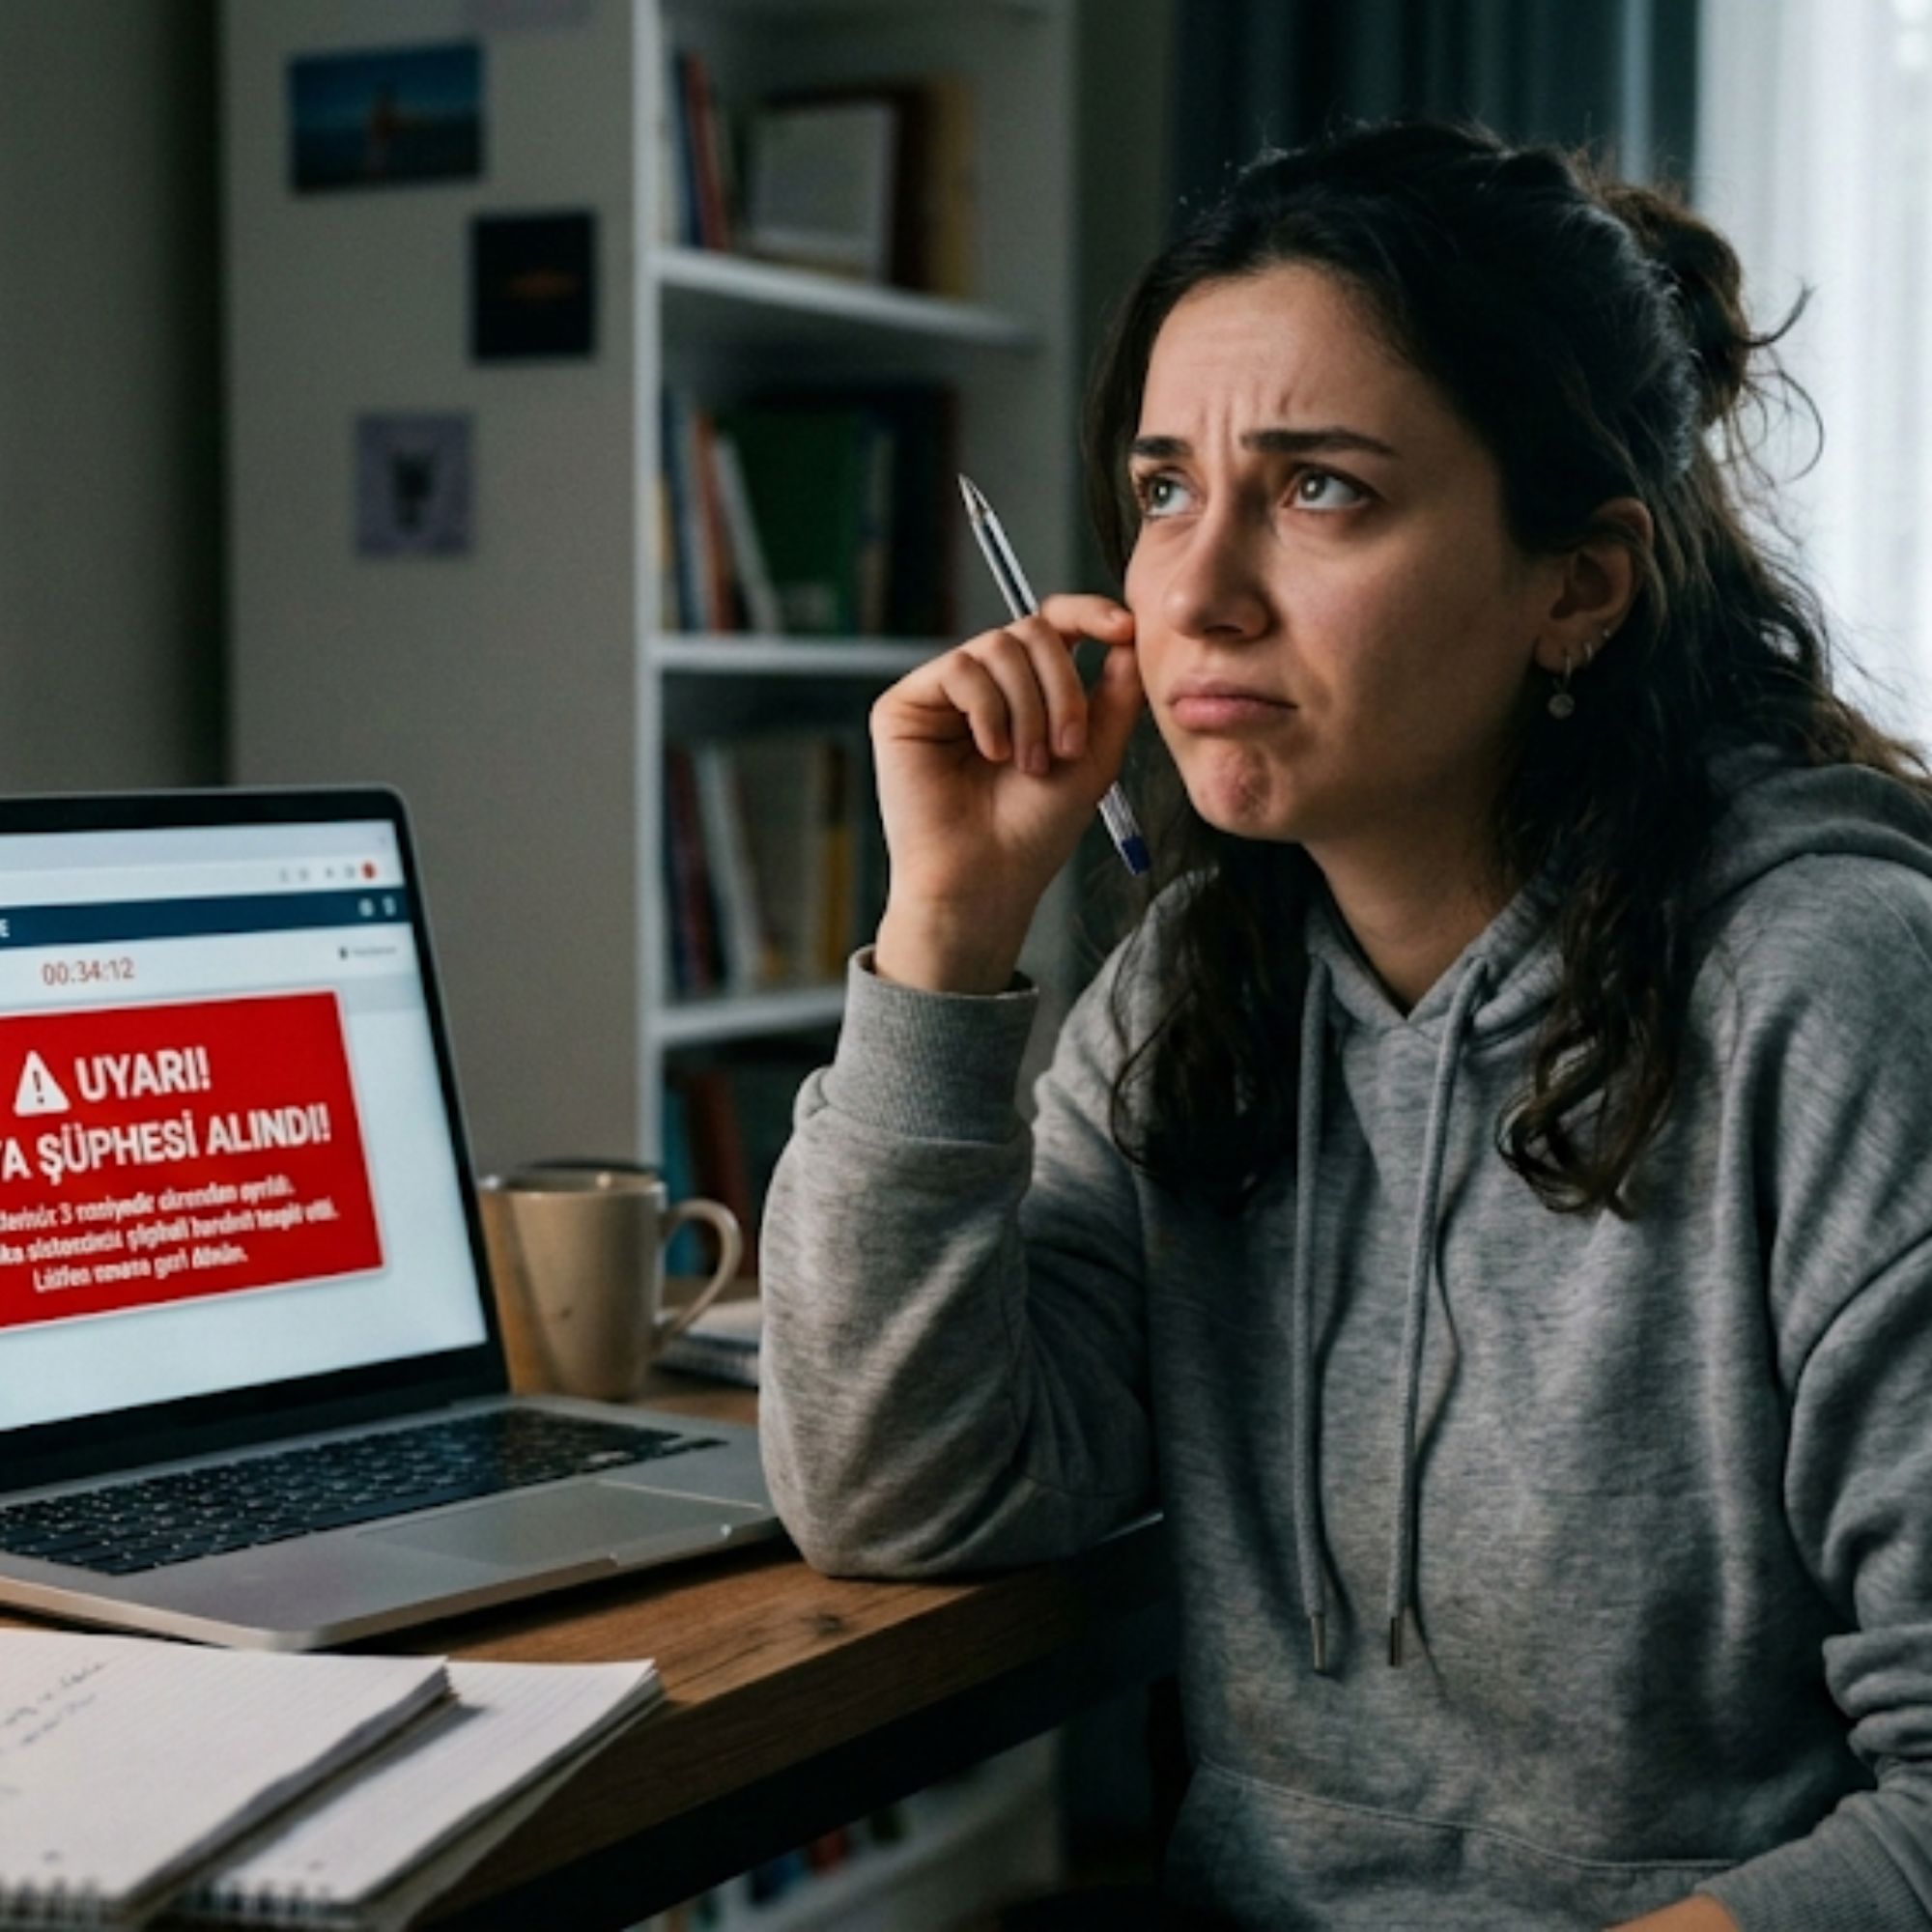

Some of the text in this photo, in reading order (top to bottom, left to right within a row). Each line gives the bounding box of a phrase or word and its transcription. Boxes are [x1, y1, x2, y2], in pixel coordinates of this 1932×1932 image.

[42, 956, 134, 985] 00:34:12
[74, 1046, 211, 1101] UYARI!
[36, 1110, 199, 1186] ŞÜPHESİ
[206, 1103, 332, 1155] ALINDI!
